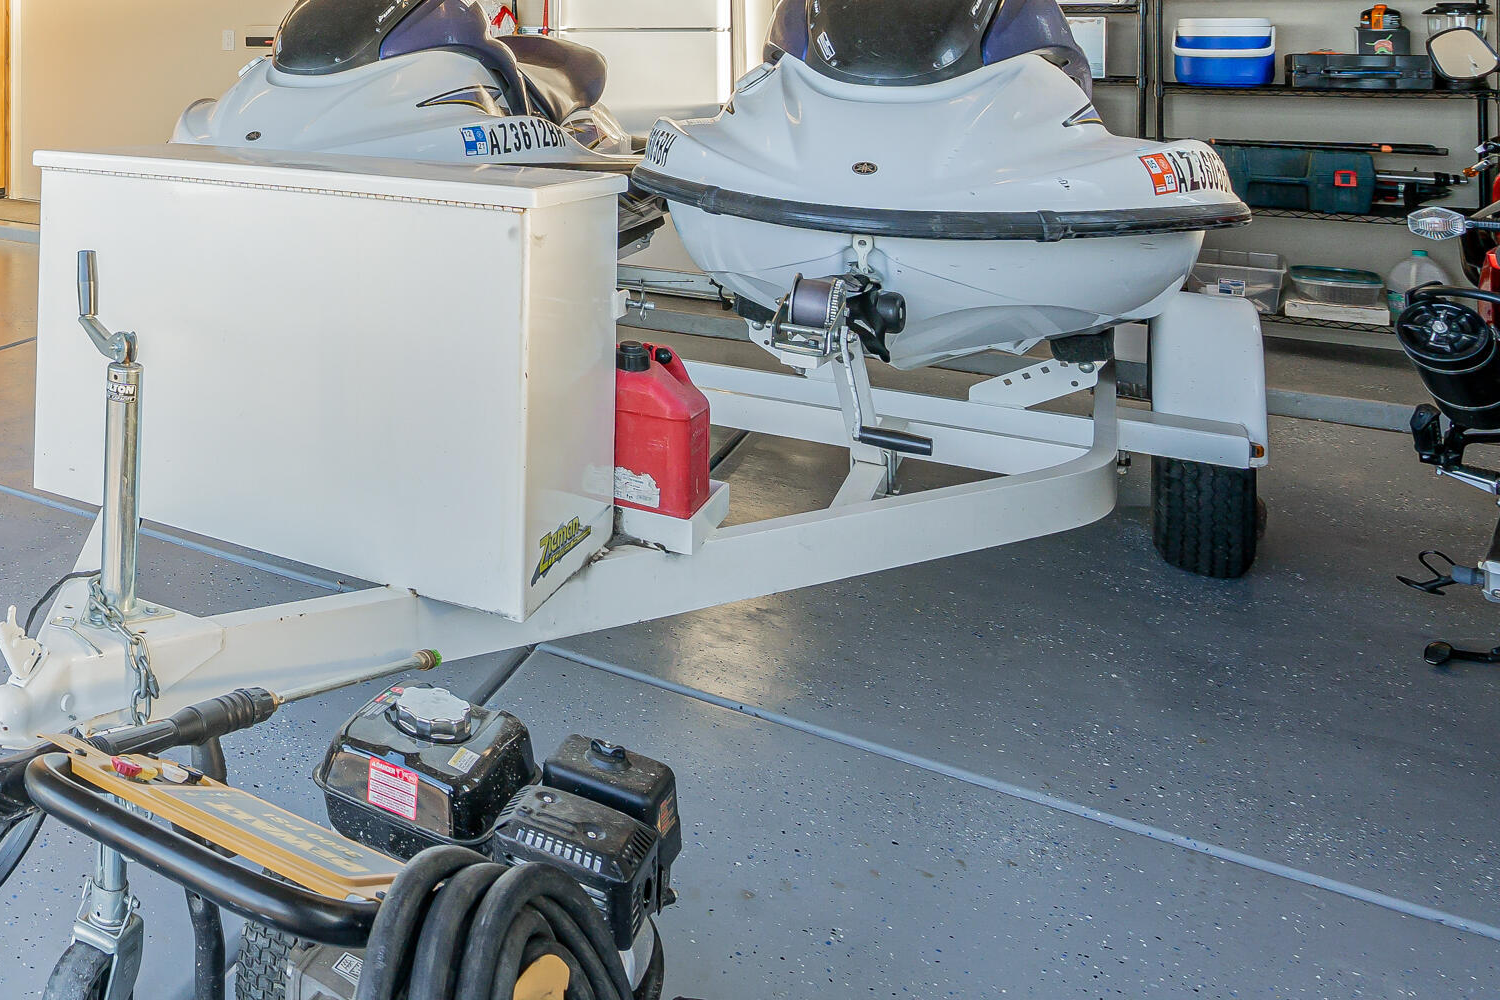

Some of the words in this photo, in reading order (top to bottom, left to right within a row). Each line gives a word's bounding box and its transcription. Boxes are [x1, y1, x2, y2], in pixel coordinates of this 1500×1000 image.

[463, 130, 472, 138] 12
[1146, 160, 1157, 169] 05
[1165, 174, 1174, 185] 22
